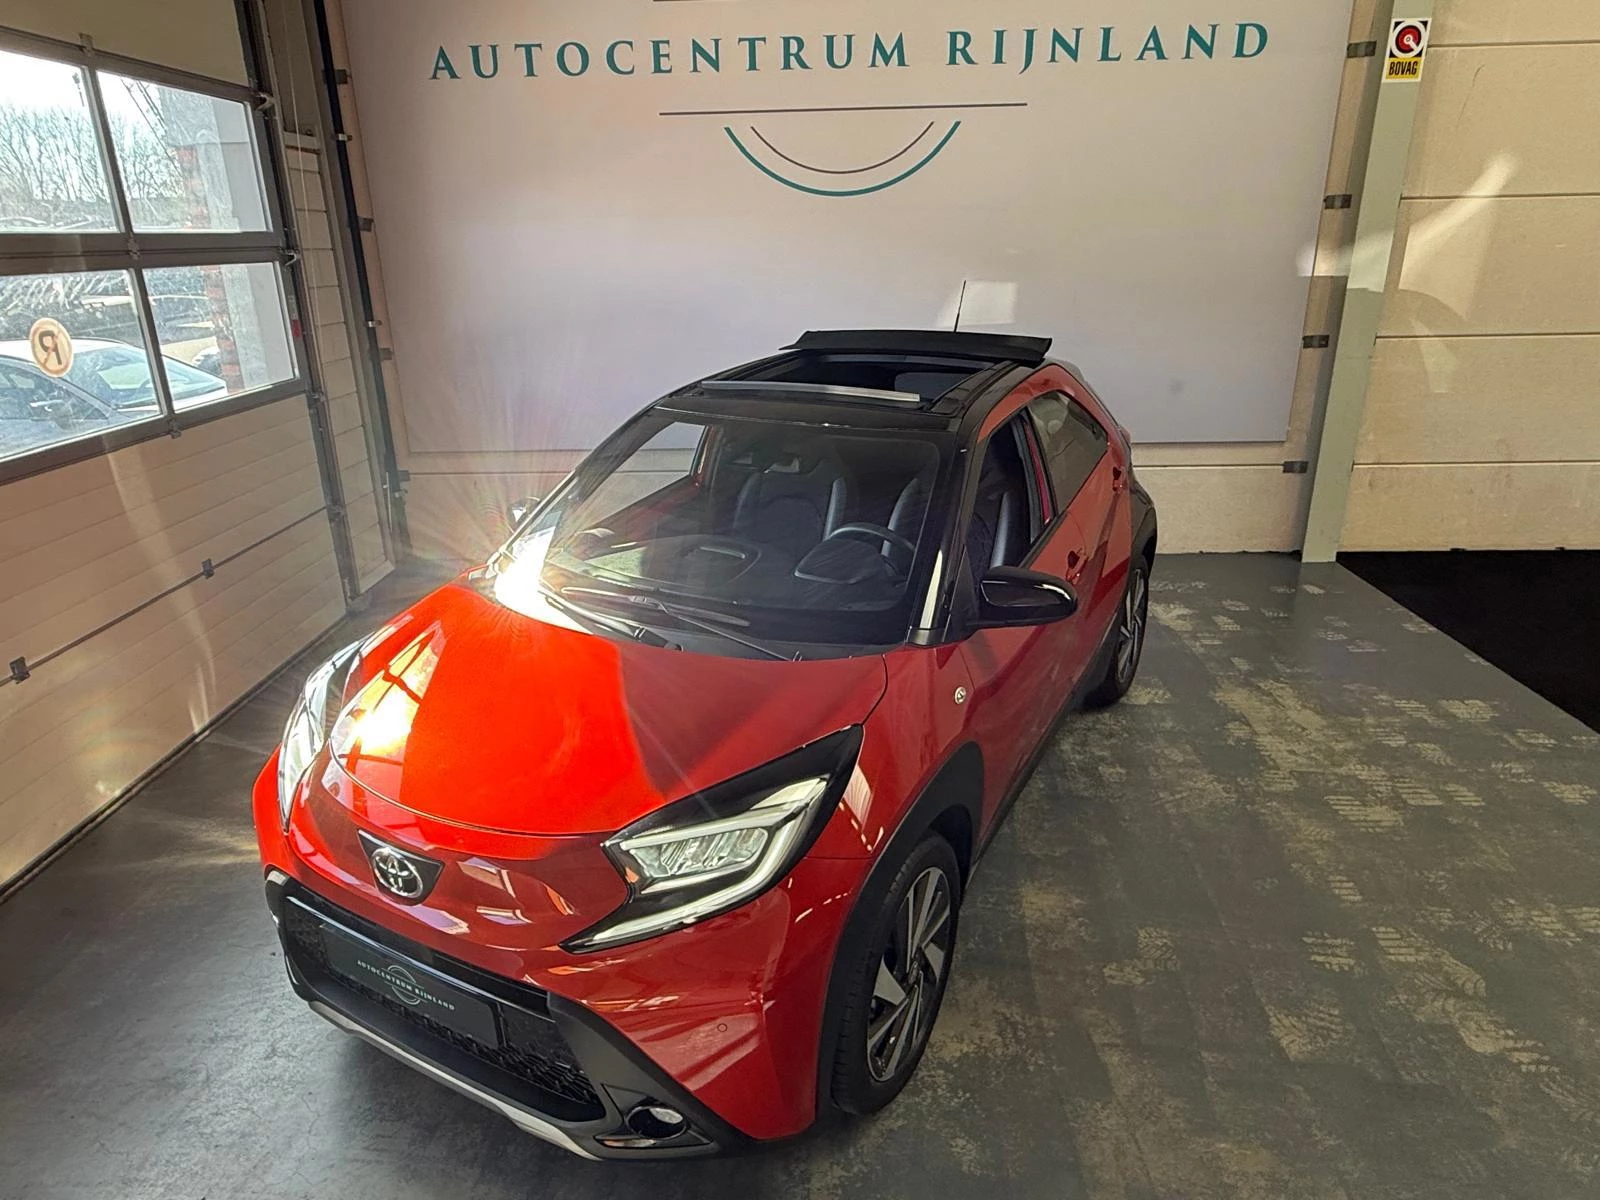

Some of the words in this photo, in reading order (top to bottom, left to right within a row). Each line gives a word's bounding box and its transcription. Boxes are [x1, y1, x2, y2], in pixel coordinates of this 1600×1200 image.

[429, 31, 910, 80] AUTOCENTRUM
[946, 22, 1270, 74] RIJNLAND
[1388, 60, 1419, 77] BOVAG
[357, 959, 413, 991] AUTOCENTRUM
[415, 987, 455, 1011] RIJNLAND
